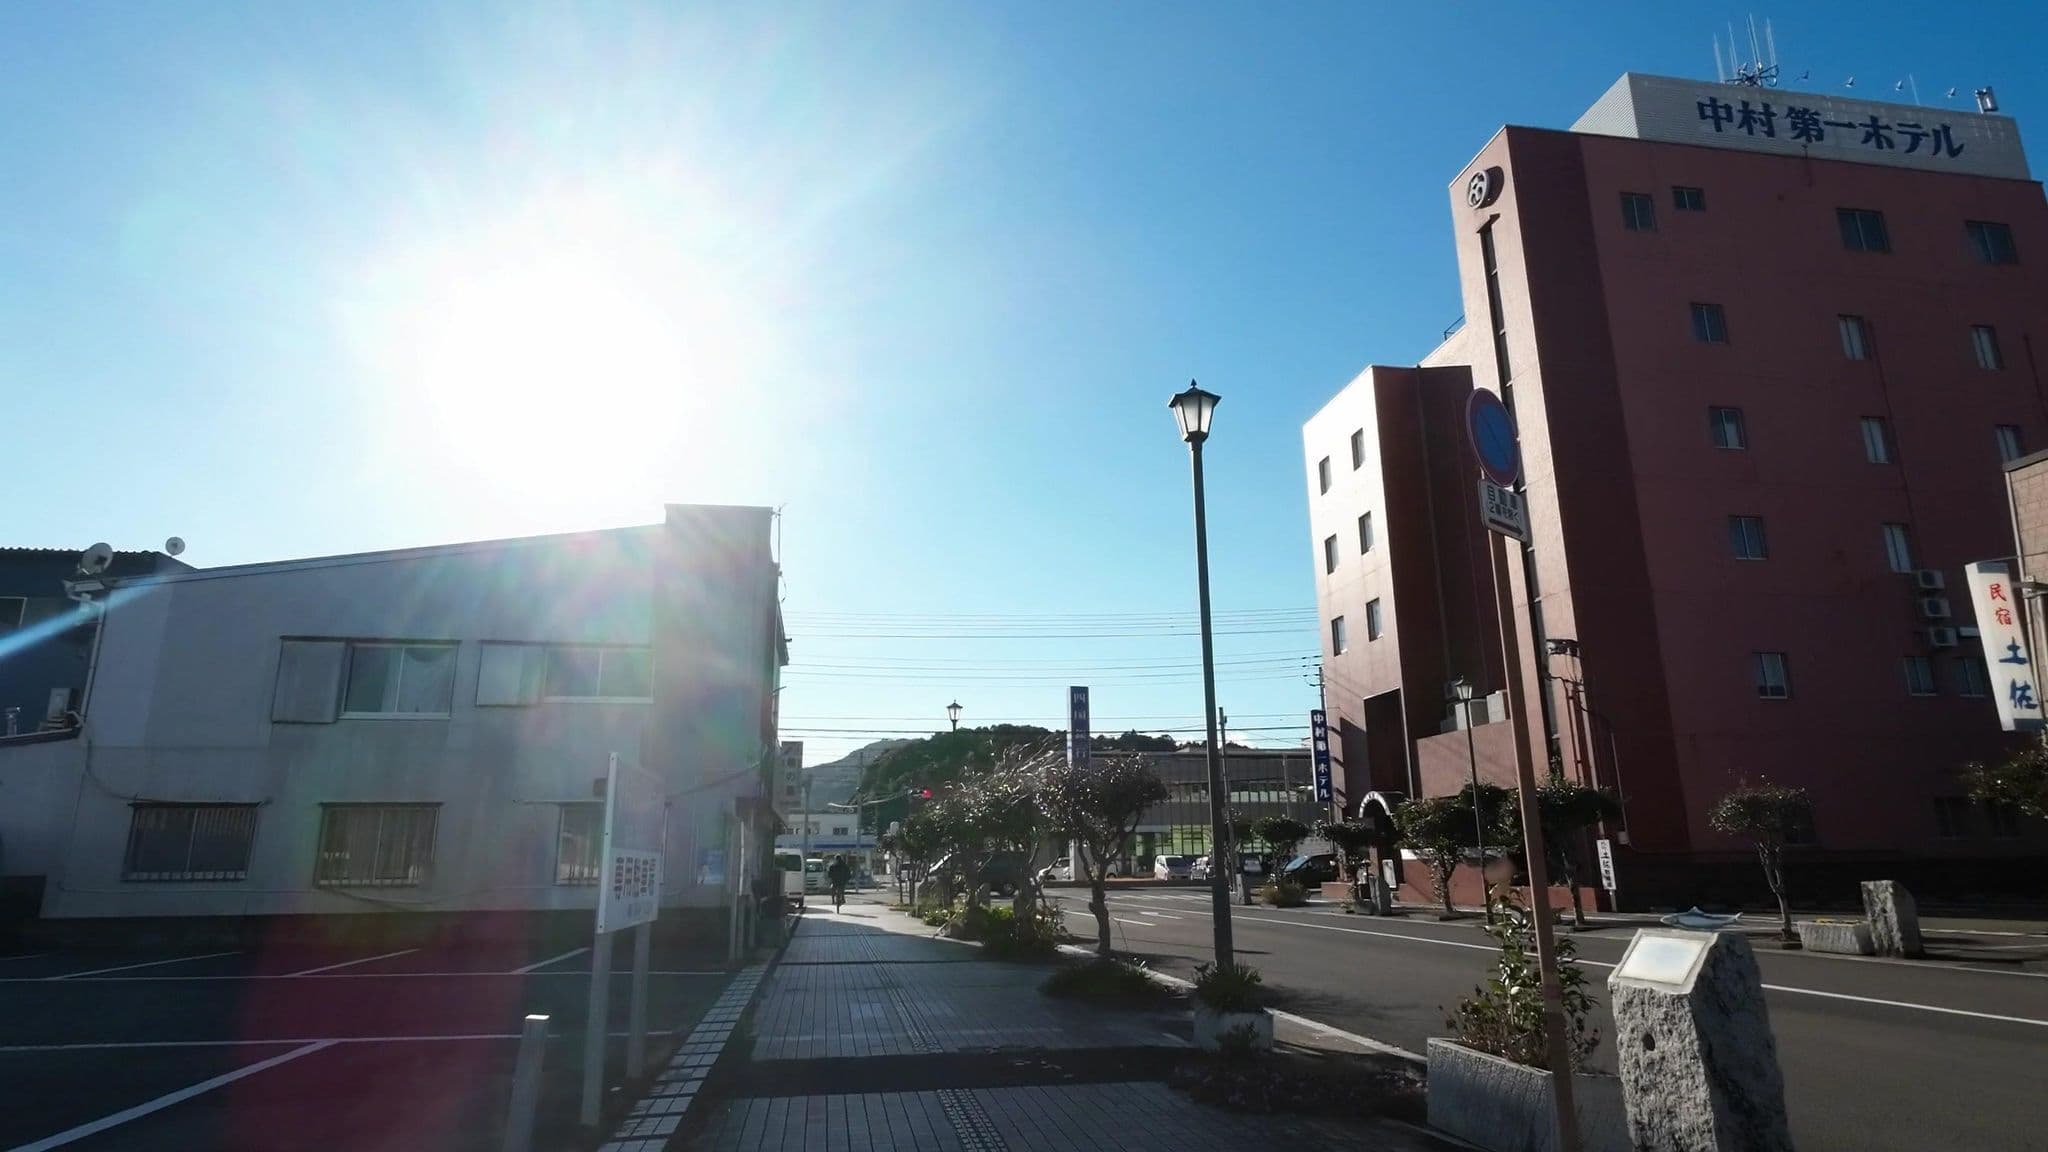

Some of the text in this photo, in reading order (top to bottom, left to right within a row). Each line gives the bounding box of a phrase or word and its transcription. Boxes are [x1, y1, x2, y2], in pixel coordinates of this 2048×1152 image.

[1696, 96, 1965, 158] 中村第一ホテル
[1313, 713, 1330, 799] 中村第一ホテル
